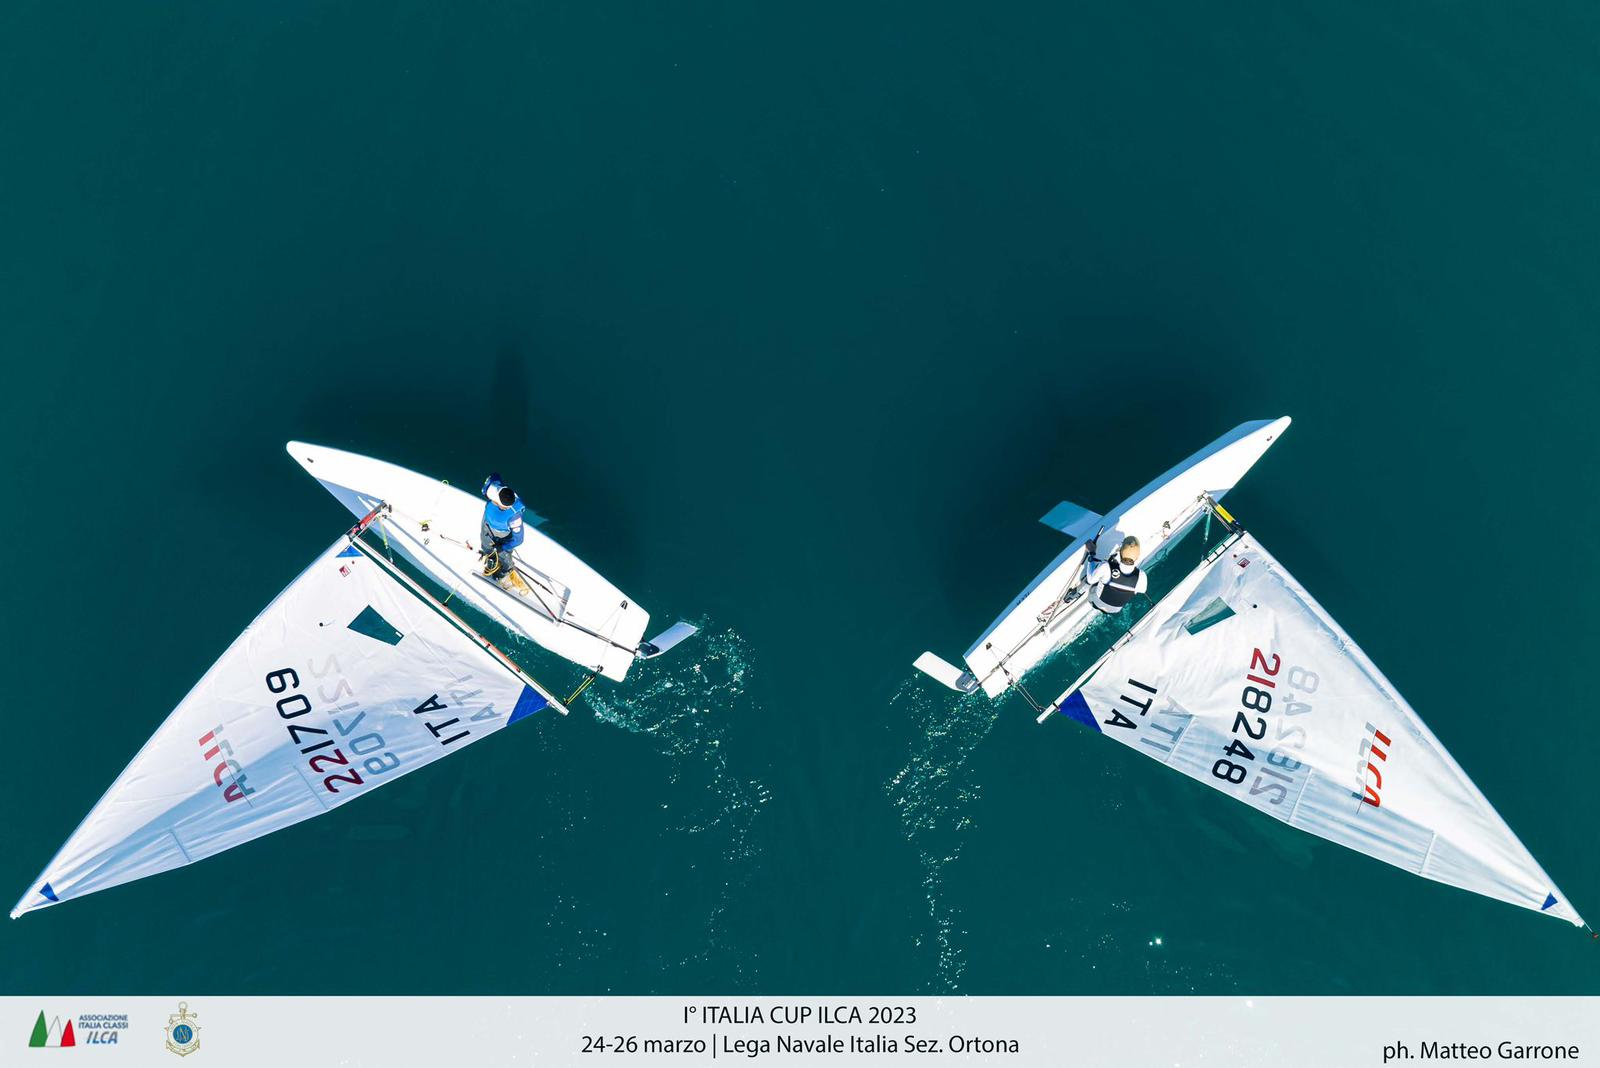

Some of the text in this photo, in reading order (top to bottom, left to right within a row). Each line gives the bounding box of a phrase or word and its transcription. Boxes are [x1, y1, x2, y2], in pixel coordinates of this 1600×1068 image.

[265, 667, 364, 793] 221709
[413, 694, 471, 745] ITA
[1104, 678, 1158, 730] ITA
[1211, 648, 1281, 785] 218248
[1351, 721, 1391, 807] ILCA
